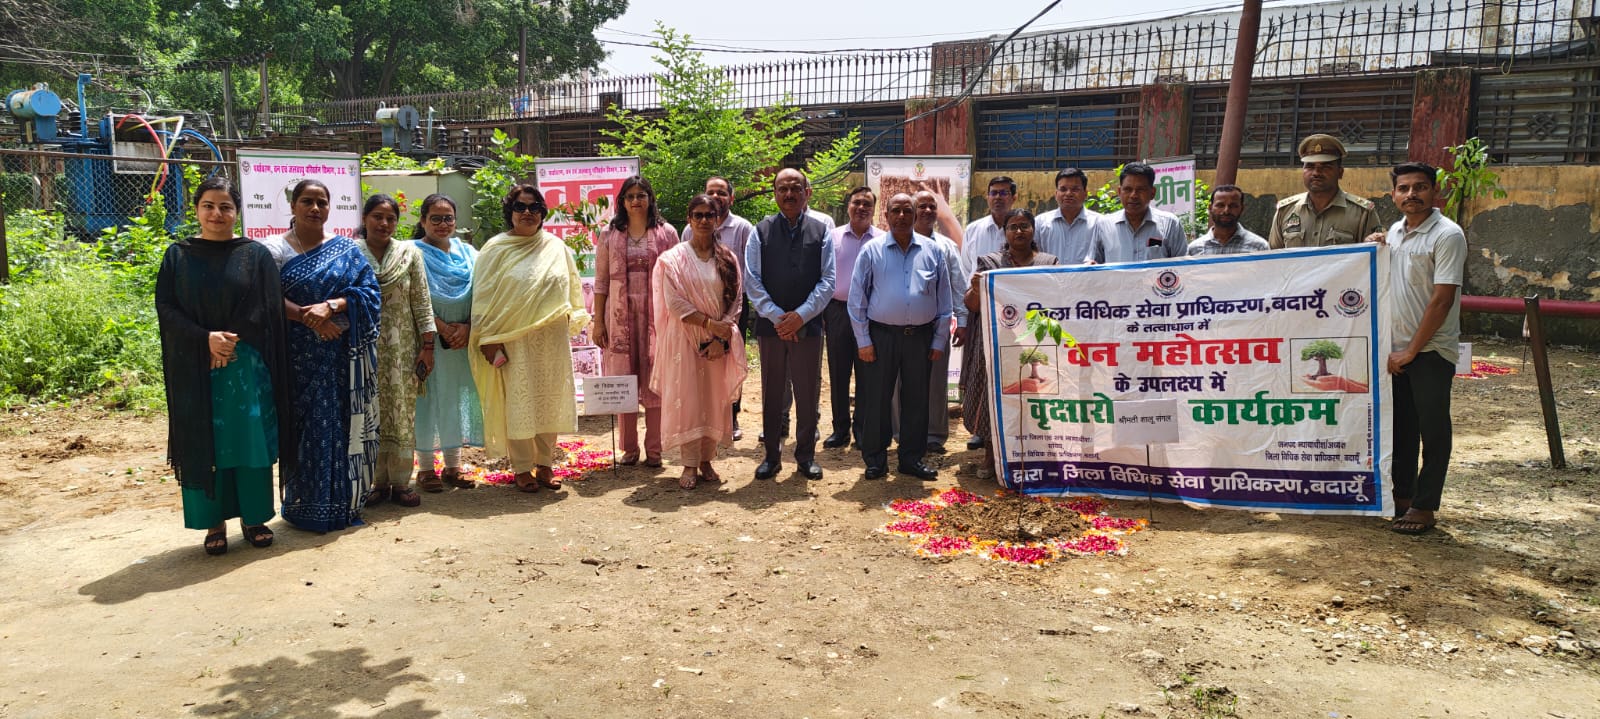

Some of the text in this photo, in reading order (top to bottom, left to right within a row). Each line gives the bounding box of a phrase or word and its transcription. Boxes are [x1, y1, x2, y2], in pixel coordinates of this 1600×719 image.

[1076, 300, 1131, 320] विधिक
[1136, 299, 1171, 318] सेवा
[1127, 322, 1140, 333] के
[1198, 319, 1211, 331] में
[1064, 333, 1284, 367] वन महोत्सव
[1113, 371, 1228, 392] के उपलक्ष्य में
[1188, 390, 1340, 426] कार्यक्रम
[1119, 414, 1138, 424] श्रीमती
[1265, 450, 1279, 460] जिला
[1013, 468, 1044, 484] द्वारा
[1062, 464, 1105, 481] जिला
[1109, 466, 1164, 486] विधिक
[1168, 470, 1205, 488] सेवा
